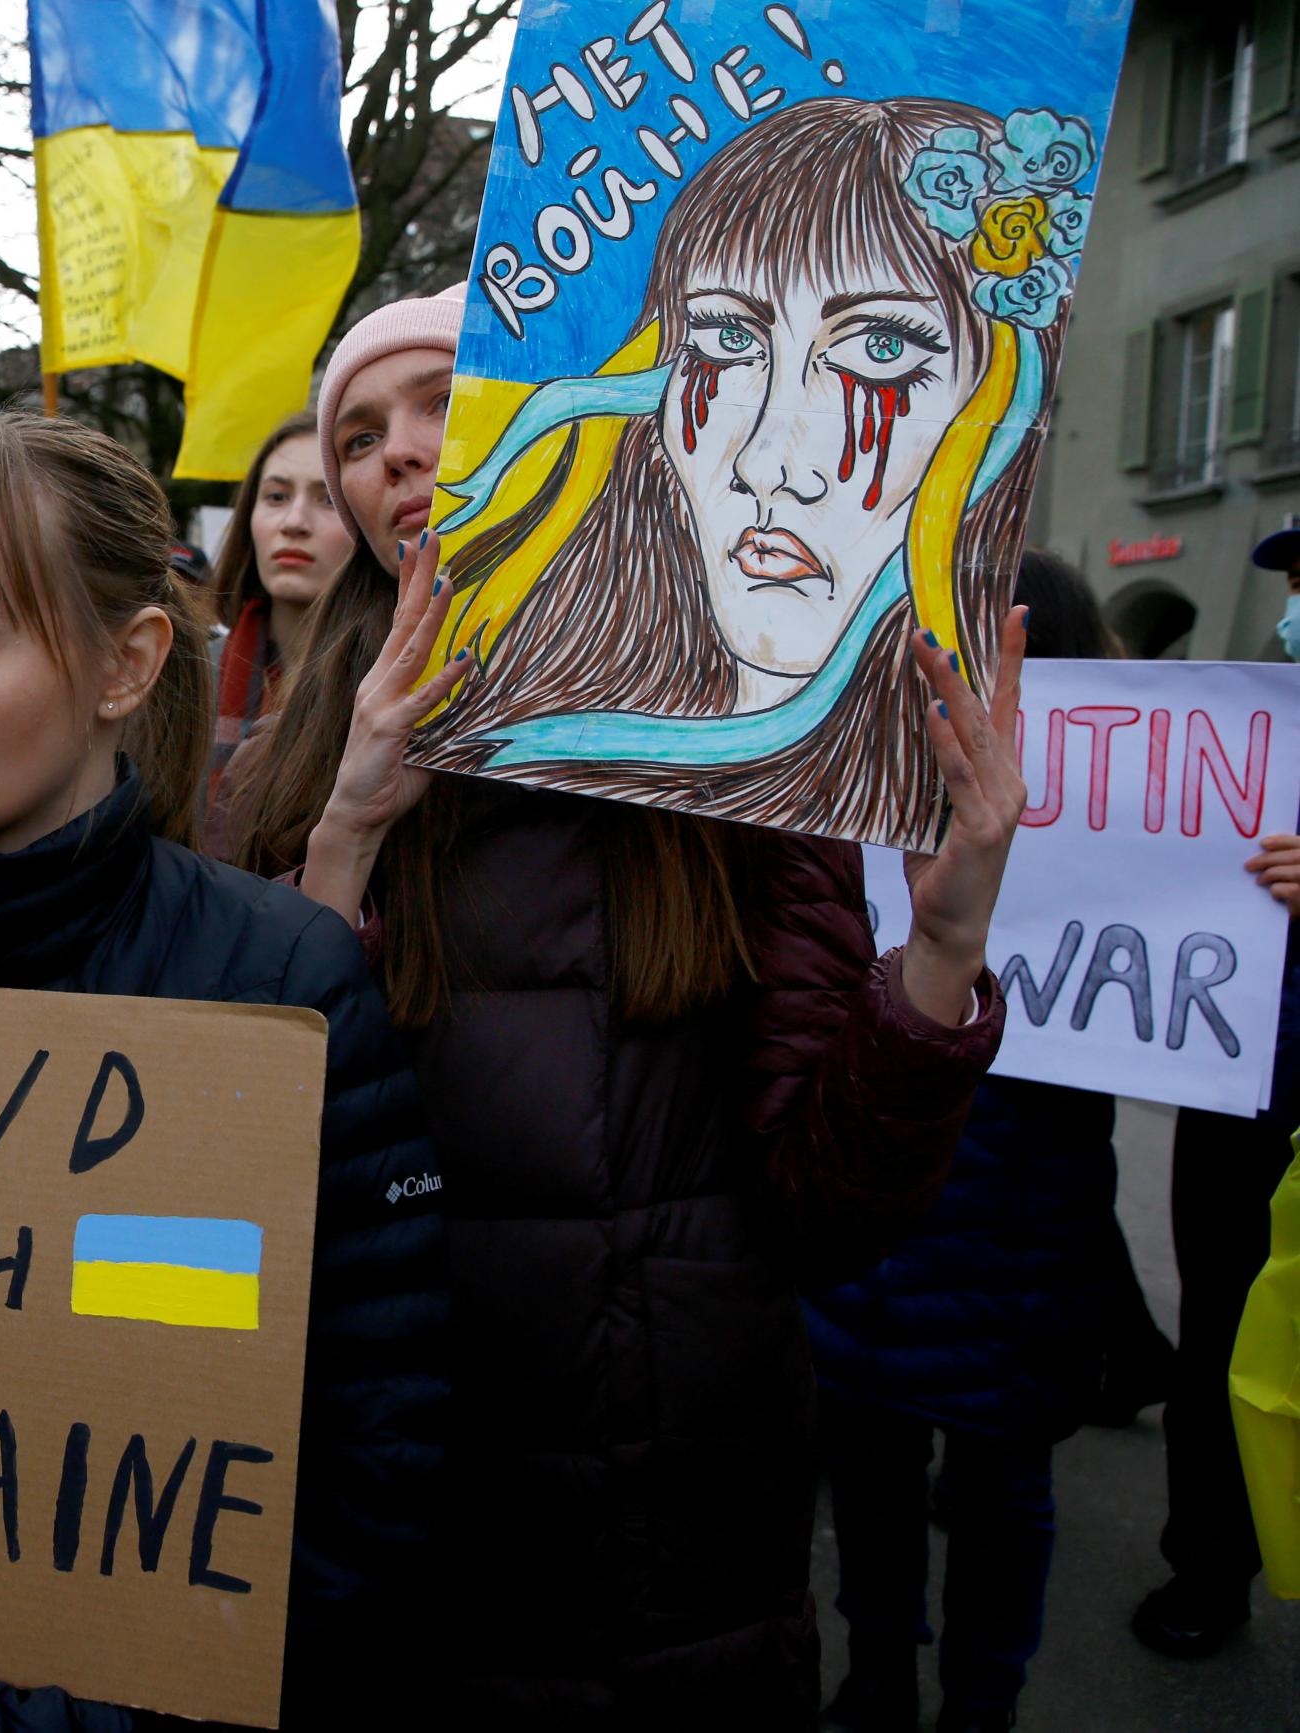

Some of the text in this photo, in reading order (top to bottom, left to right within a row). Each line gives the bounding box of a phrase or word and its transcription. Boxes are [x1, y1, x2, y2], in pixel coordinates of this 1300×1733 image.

[510, 0, 697, 167] НЕТ
[478, 3, 847, 341] ВОЙНЕ!
[1017, 706, 1271, 839] UTIN
[999, 920, 1241, 1058] WAR
[403, 1172, 443, 1197] Colu
